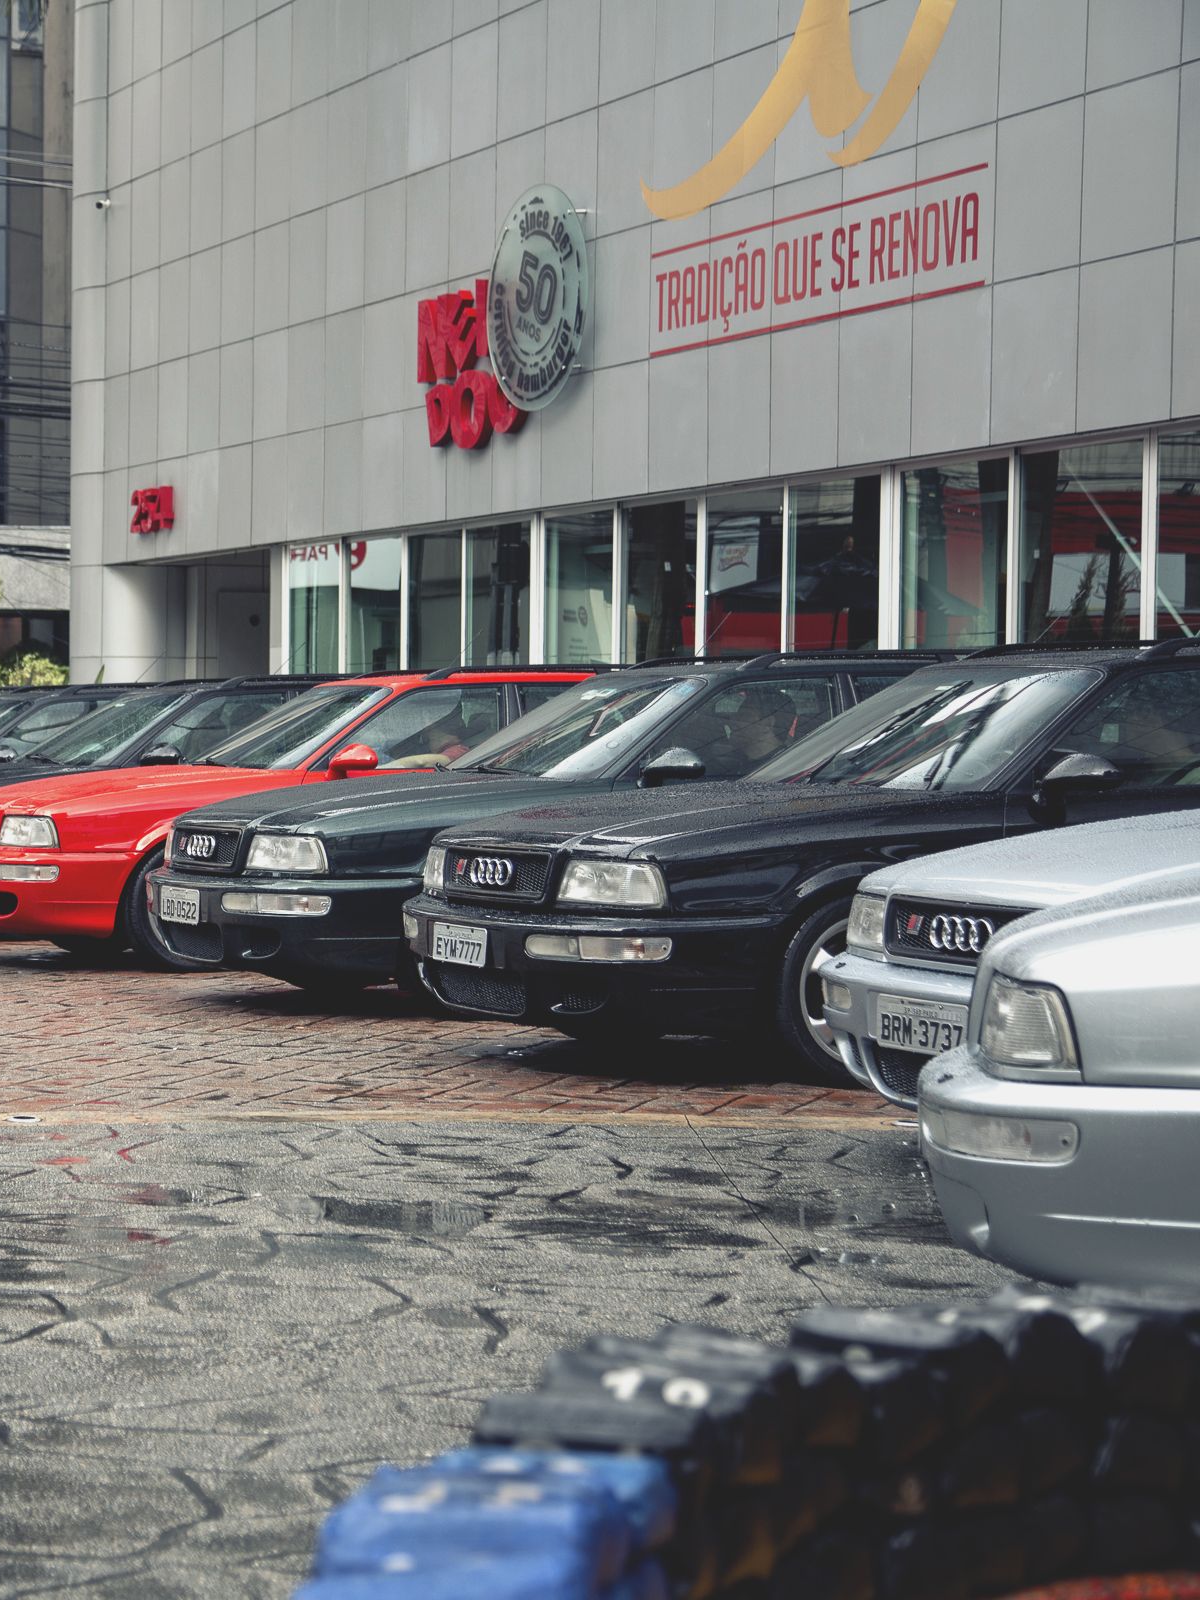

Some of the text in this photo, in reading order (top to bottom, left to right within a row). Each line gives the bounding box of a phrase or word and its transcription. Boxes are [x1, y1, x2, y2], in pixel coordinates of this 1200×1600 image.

[519, 210, 574, 261] since 1967
[656, 192, 980, 332] TRADIÇÃO QUE SE RENOVA
[515, 250, 557, 325] 50
[515, 317, 541, 343] ANOS
[163, 898, 197, 919] LBD-0522
[881, 1013, 963, 1050] BRM-3737
